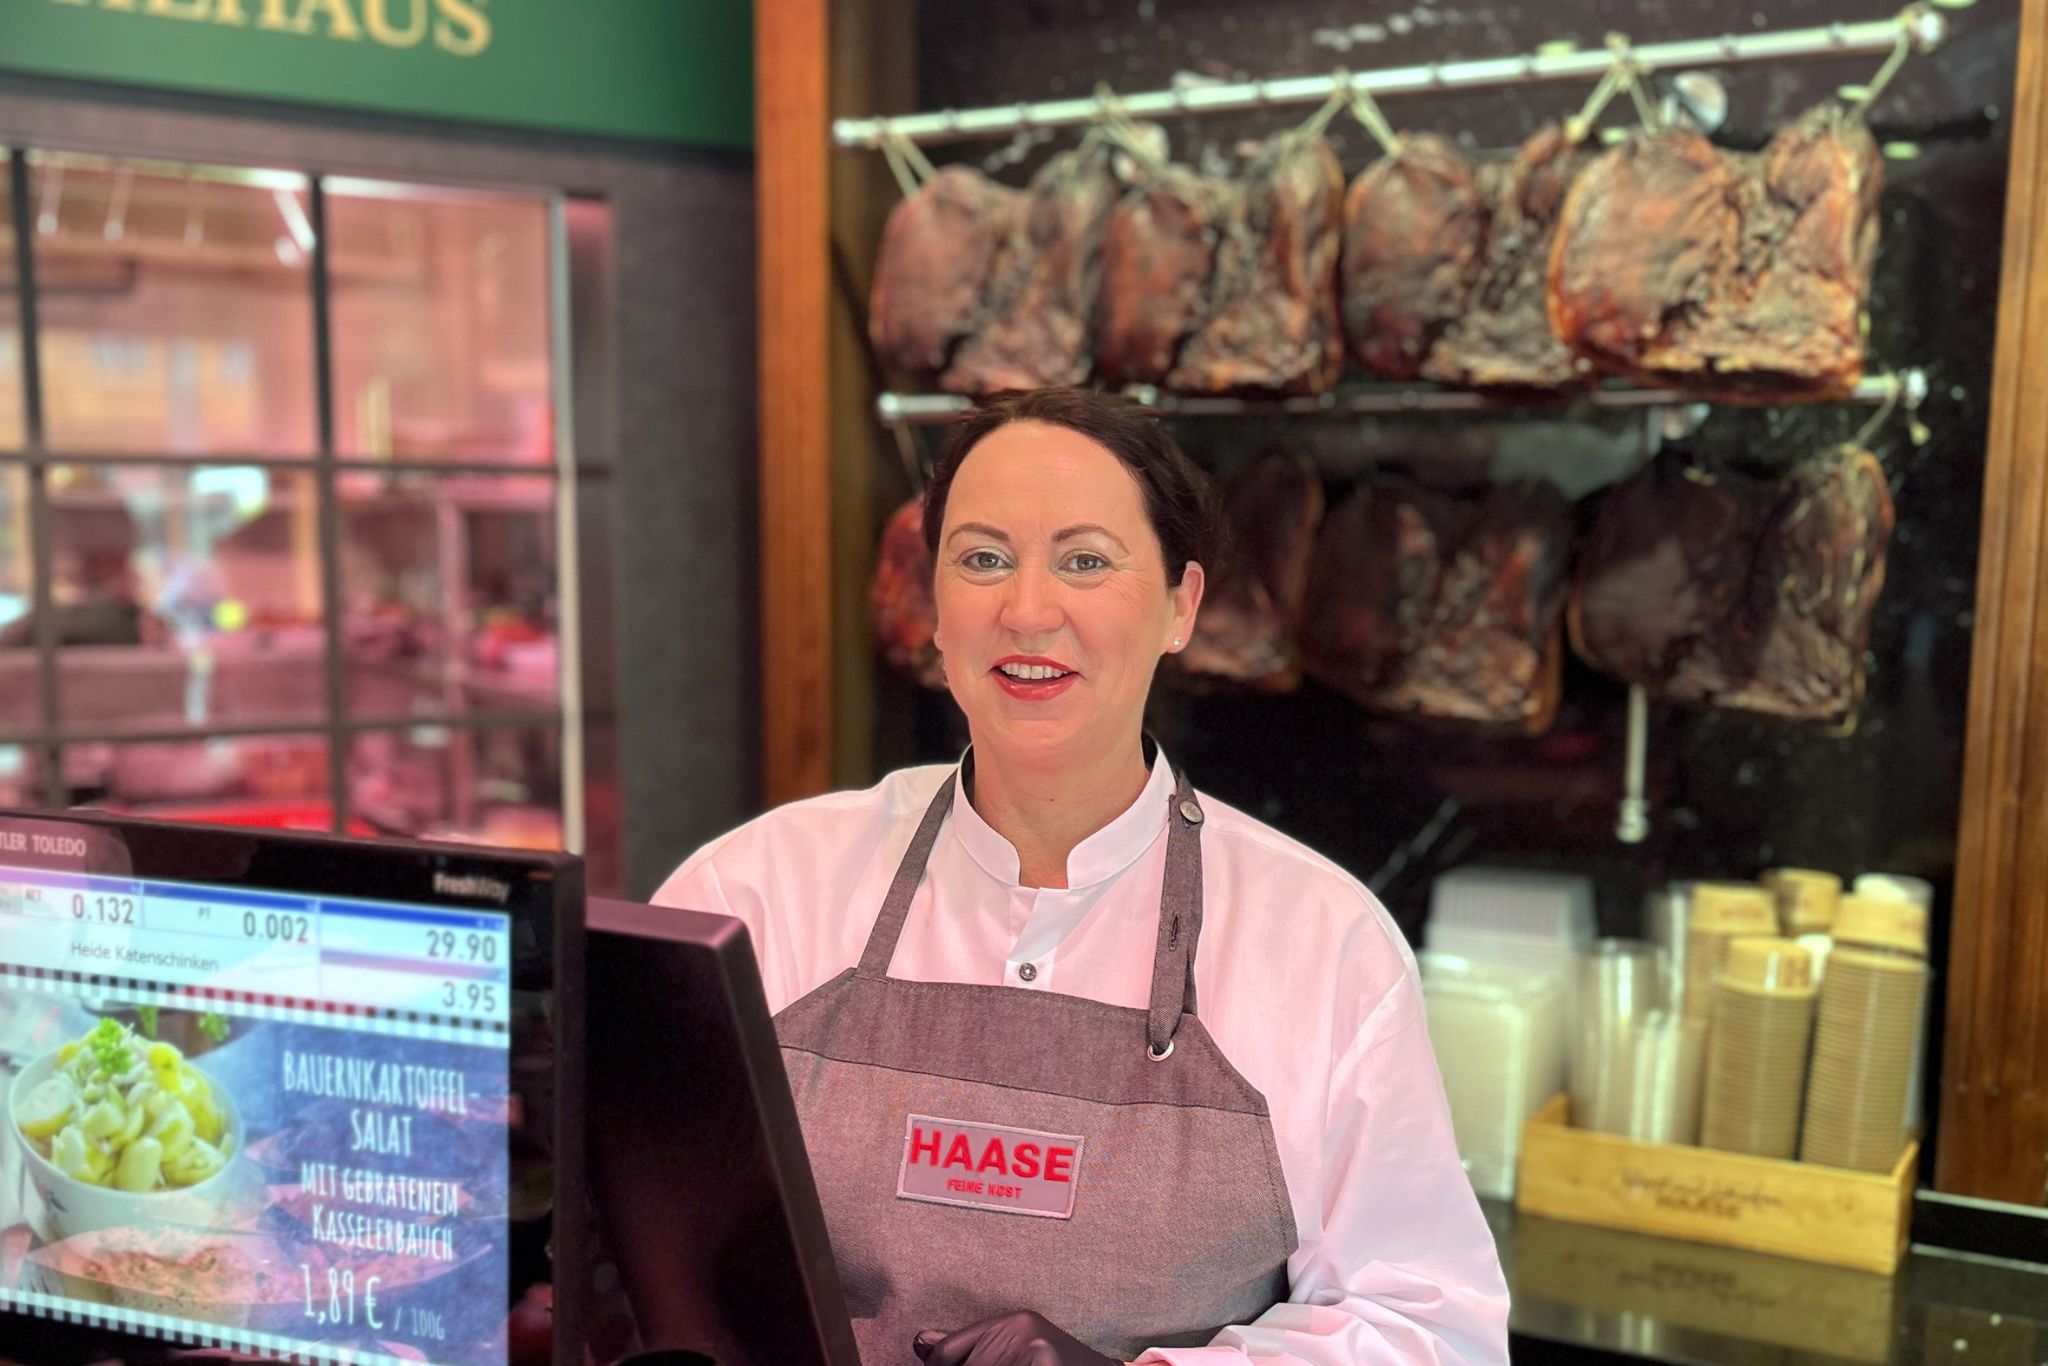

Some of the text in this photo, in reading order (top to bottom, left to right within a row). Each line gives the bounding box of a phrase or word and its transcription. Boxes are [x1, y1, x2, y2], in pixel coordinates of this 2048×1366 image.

[32, 834, 87, 857] TOLEDO
[71, 893, 135, 925] 0.132
[243, 911, 309, 943] 0.002
[71, 941, 219, 972] Heide Katenschinken
[426, 929, 497, 963] 29.90
[441, 980, 497, 1013] 3.95
[351, 1108, 412, 1157] SALAT
[909, 1126, 1075, 1183] HAASE
[301, 1162, 459, 1218] MIT GEBRATENEM
[947, 1178, 1023, 1199] FEINE KOST
[312, 1204, 454, 1262] KASSELERBAUCH
[301, 1264, 354, 1325] 1,89
[365, 1276, 383, 1329] €
